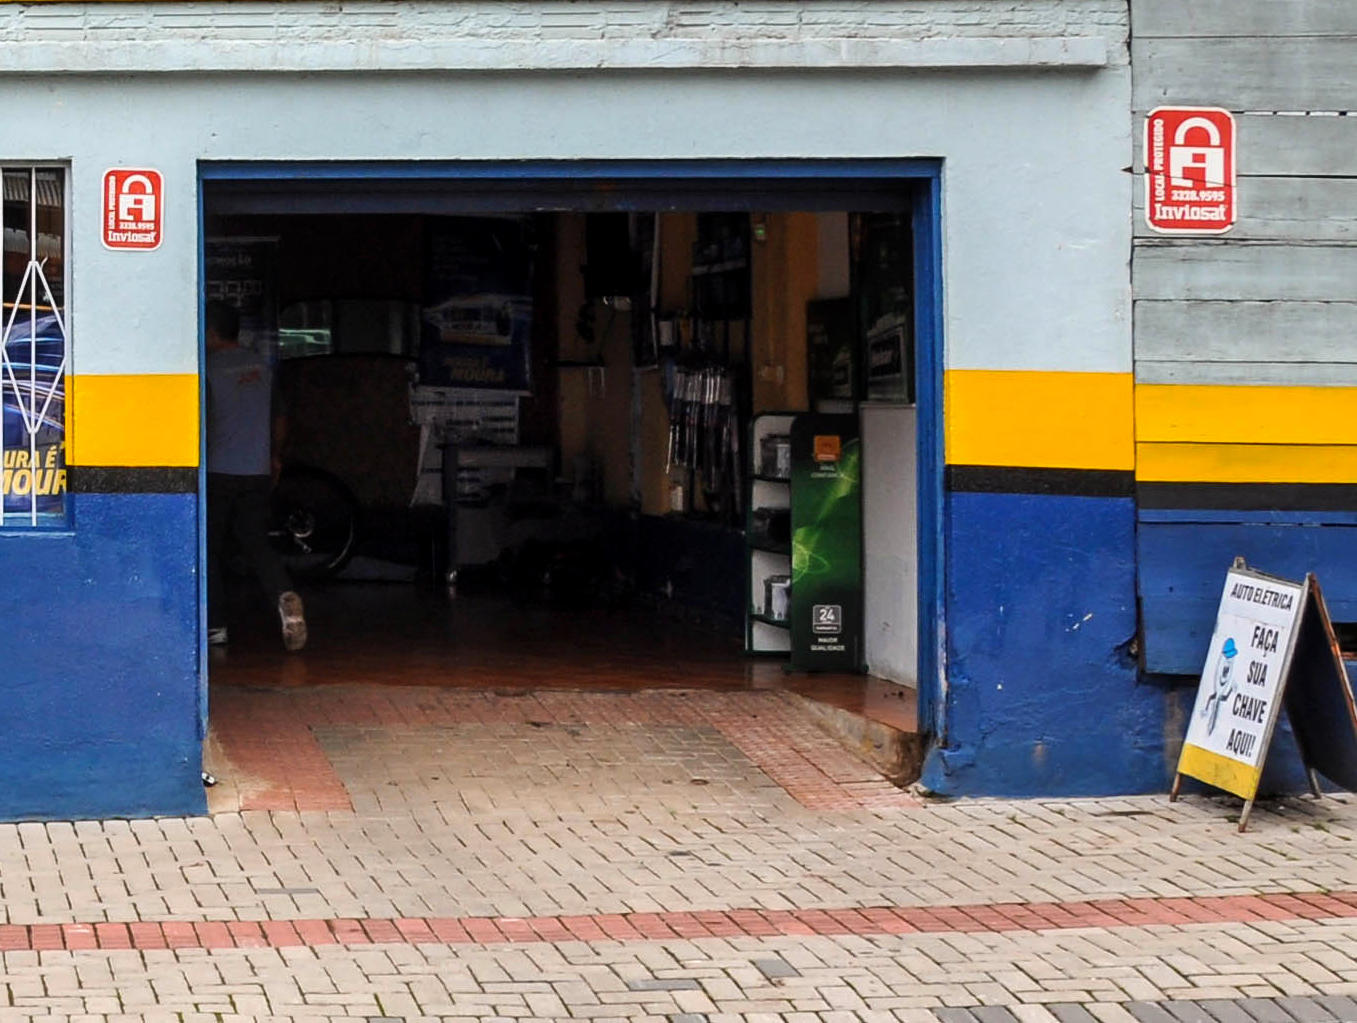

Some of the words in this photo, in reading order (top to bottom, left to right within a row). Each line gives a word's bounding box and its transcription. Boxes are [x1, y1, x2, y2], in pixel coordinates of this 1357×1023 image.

[1154, 203, 1228, 220] Inviosat
[108, 230, 157, 243] Inviosat
[1230, 582, 1254, 601] AUTO
[819, 608, 835, 621] 24
[1251, 626, 1278, 657] FAÇA
[1247, 661, 1268, 687] SUA
[1232, 693, 1268, 724] CHAVE
[1226, 729, 1256, 758] AQUI!
